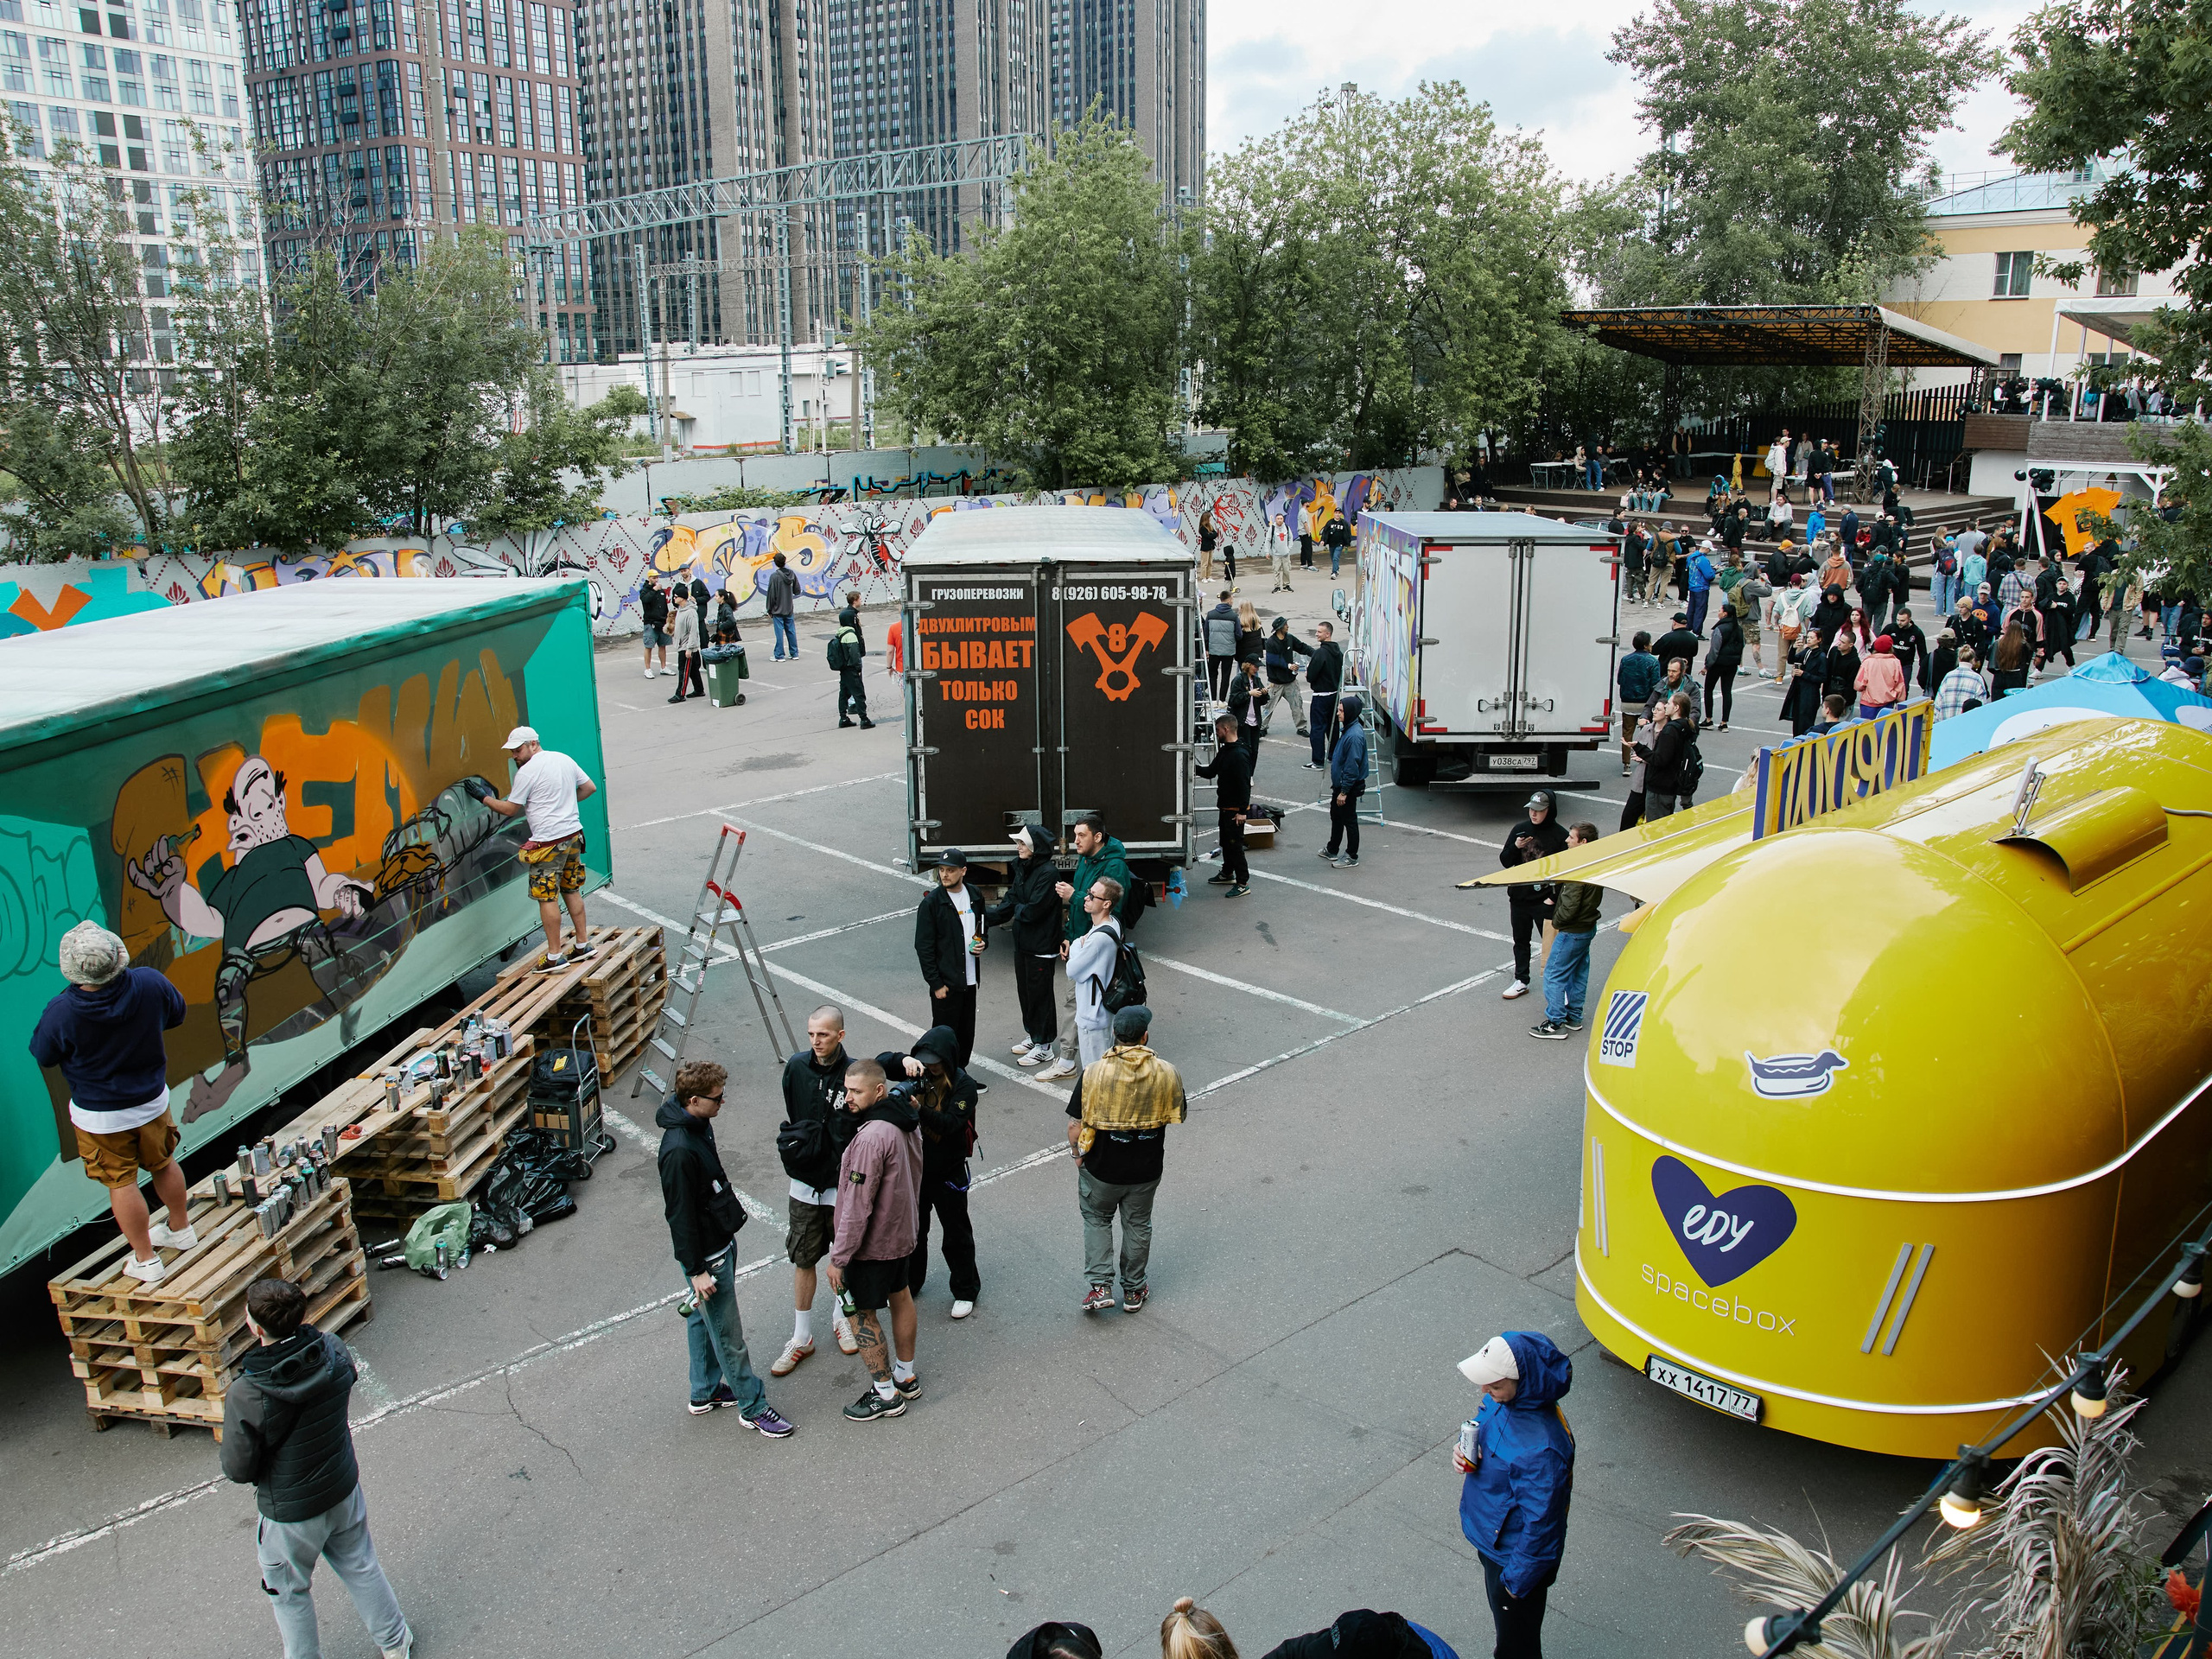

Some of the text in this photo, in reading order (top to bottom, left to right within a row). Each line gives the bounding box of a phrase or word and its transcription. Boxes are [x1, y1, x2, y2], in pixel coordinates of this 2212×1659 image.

[931, 588, 1024, 601] ГРУЗОПЕРЕВОЗКИ
[1052, 586, 1167, 601] 8 (926) 605-98-78
[918, 616, 1036, 635] ДВУХЛИТРОВЫМ
[922, 640, 1034, 670] БЫВАЕТ
[940, 680, 1018, 701] ТОЛЬКО
[965, 709, 1005, 730] СОК
[1601, 1039, 1633, 1058] STOP
[1641, 1263, 1796, 1337] spacebox
[1684, 1376, 1727, 1406] 1417
[1732, 1392, 1751, 1410] 77
[1731, 1405, 1745, 1414] RUS
